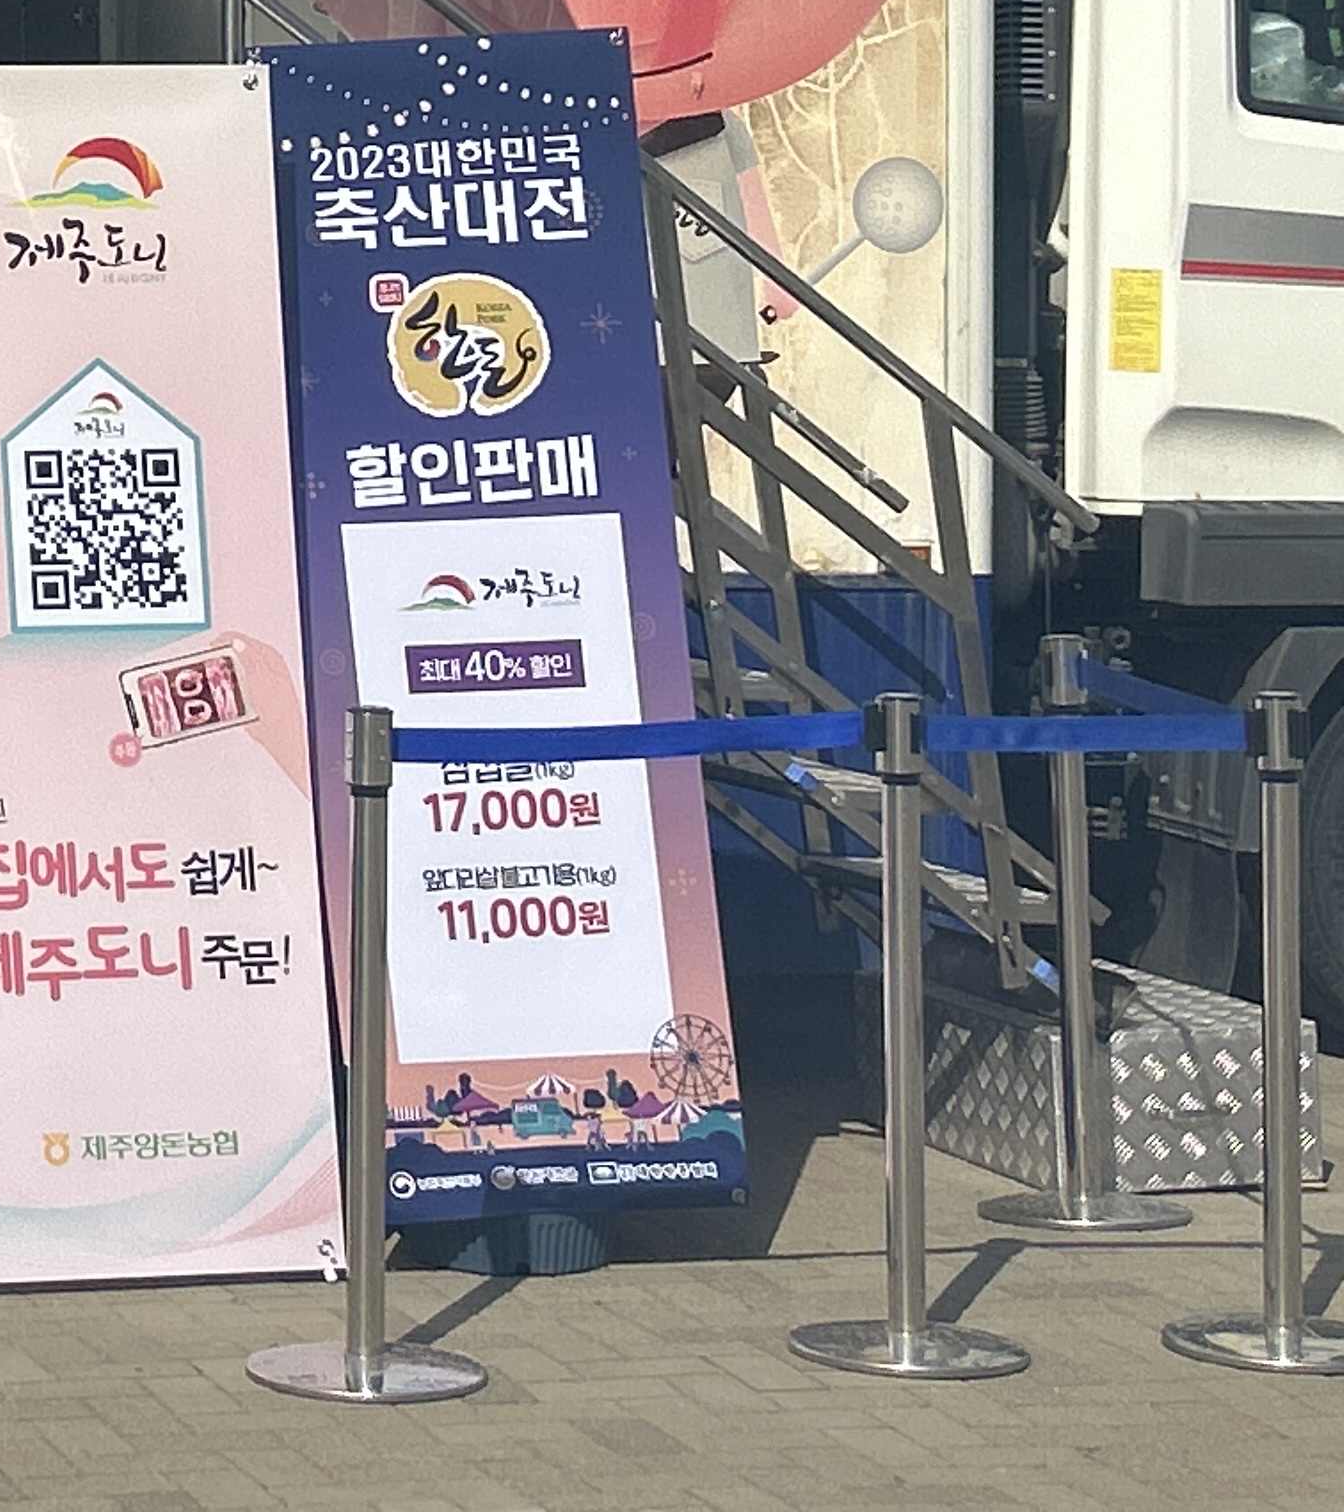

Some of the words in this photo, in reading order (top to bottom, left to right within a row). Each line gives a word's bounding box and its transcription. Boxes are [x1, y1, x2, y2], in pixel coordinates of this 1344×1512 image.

[313, 176, 589, 250] 축산대전
[4, 217, 167, 284] 제주도니
[346, 434, 598, 509] 할인판매
[479, 568, 580, 608] 제주도니
[419, 657, 462, 682] 최대
[464, 649, 526, 682] 40%
[529, 653, 573, 679] 할인
[422, 787, 602, 836] 17,000원
[180, 845, 280, 897] 쉽게~
[436, 895, 610, 944] 11,000원
[200, 933, 291, 986] 주문!
[80, 1130, 240, 1161] 제주양돈농협
